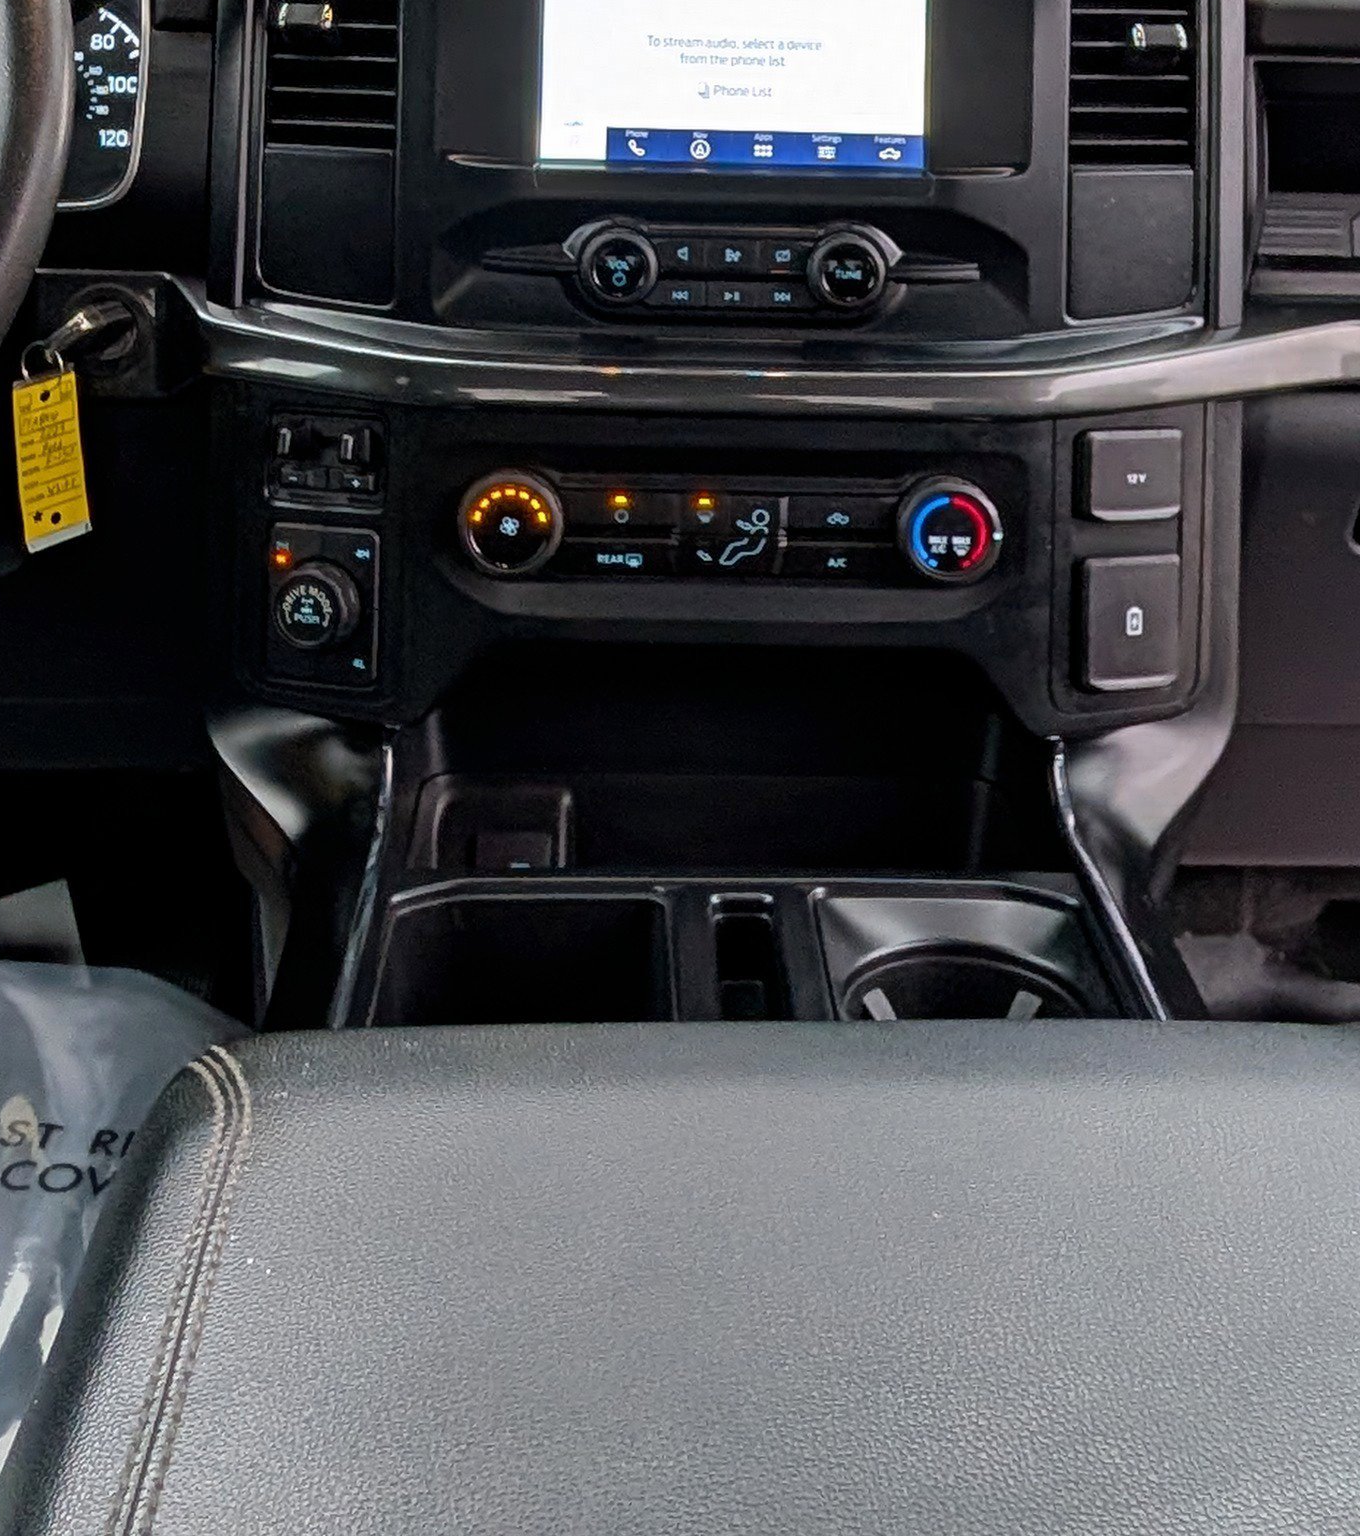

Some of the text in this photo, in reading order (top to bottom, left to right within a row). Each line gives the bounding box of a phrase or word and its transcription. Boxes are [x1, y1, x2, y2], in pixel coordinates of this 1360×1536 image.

[90, 33, 115, 50] 80
[647, 34, 661, 47] To
[663, 36, 704, 48] stream
[742, 38, 775, 50] select
[787, 39, 822, 51] device
[680, 53, 785, 67] from the phone list
[713, 84, 772, 98] Phone List
[98, 128, 129, 148] 120
[596, 553, 624, 565] REAR
[827, 556, 847, 568] A/C
[282, 584, 333, 615] DRIVE MODE
